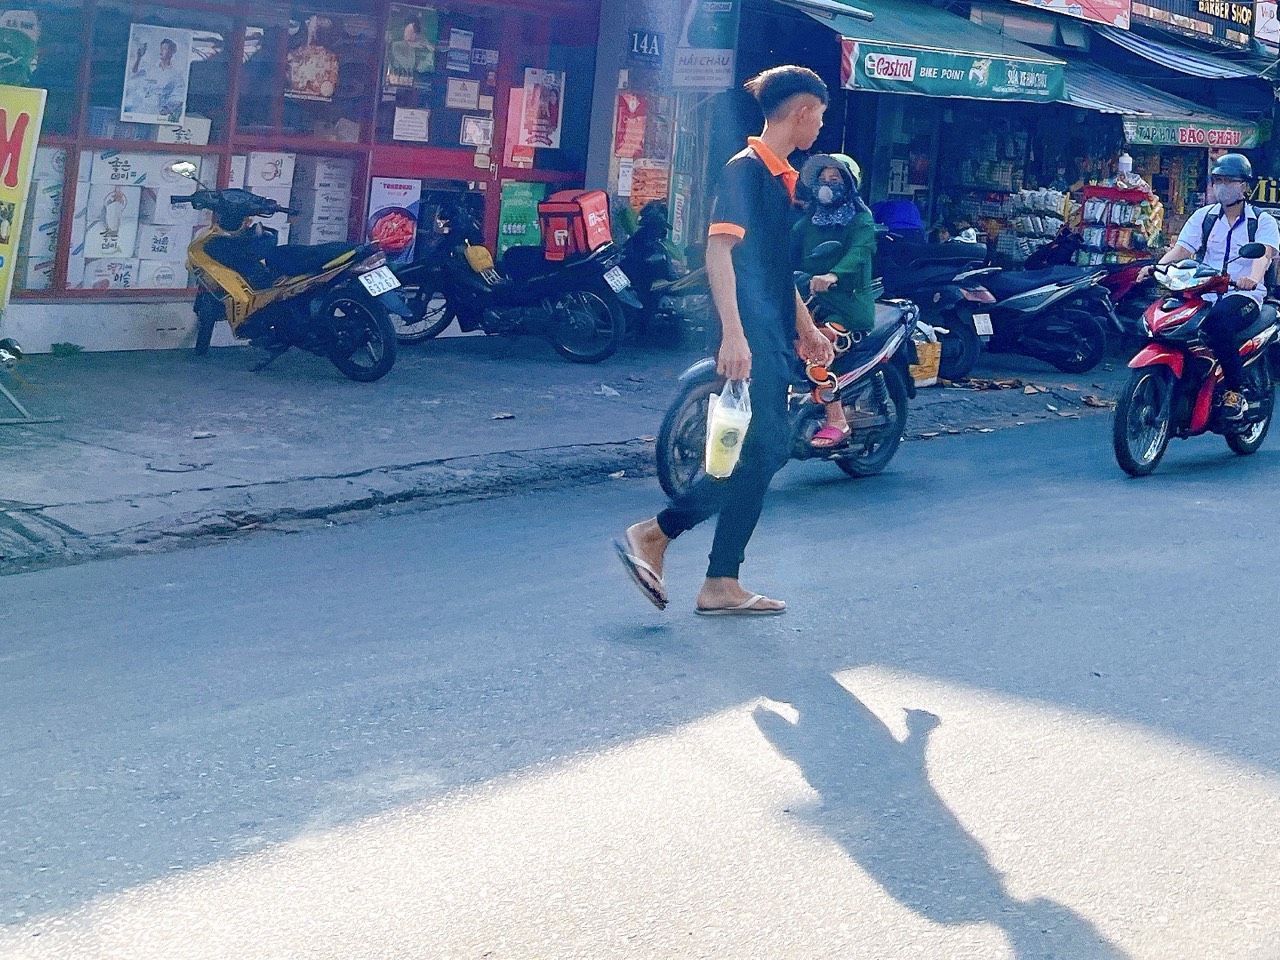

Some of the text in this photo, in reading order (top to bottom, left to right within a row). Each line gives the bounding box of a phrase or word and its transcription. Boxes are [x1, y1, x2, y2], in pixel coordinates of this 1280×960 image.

[1231, 3, 1252, 26] SHOP
[632, 32, 660, 56] 14A
[875, 56, 913, 78] Castrol
[920, 66, 938, 78] BIKE
[941, 68, 965, 81] POINT
[1179, 124, 1205, 144] BẢO
